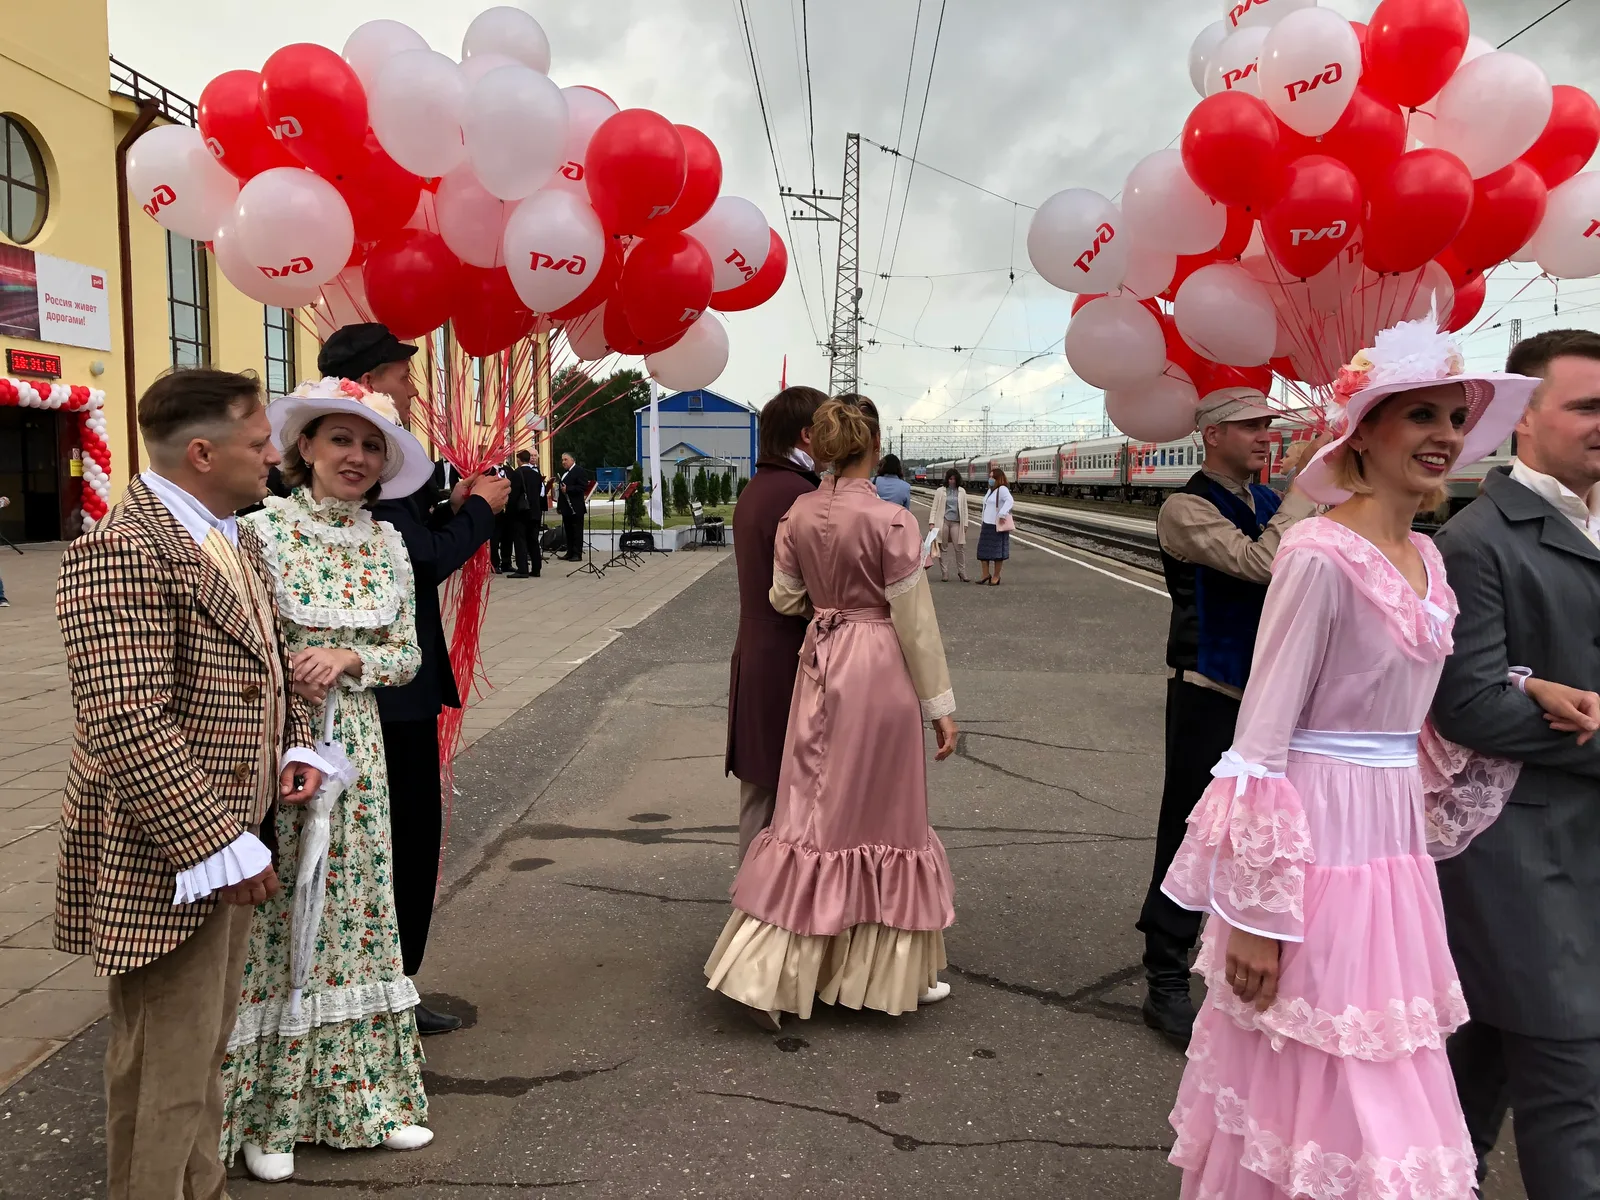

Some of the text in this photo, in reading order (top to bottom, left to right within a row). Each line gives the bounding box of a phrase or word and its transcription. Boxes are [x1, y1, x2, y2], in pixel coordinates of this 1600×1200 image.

[45, 292, 97, 313] Россия живет
[46, 311, 86, 326] дорогами!
